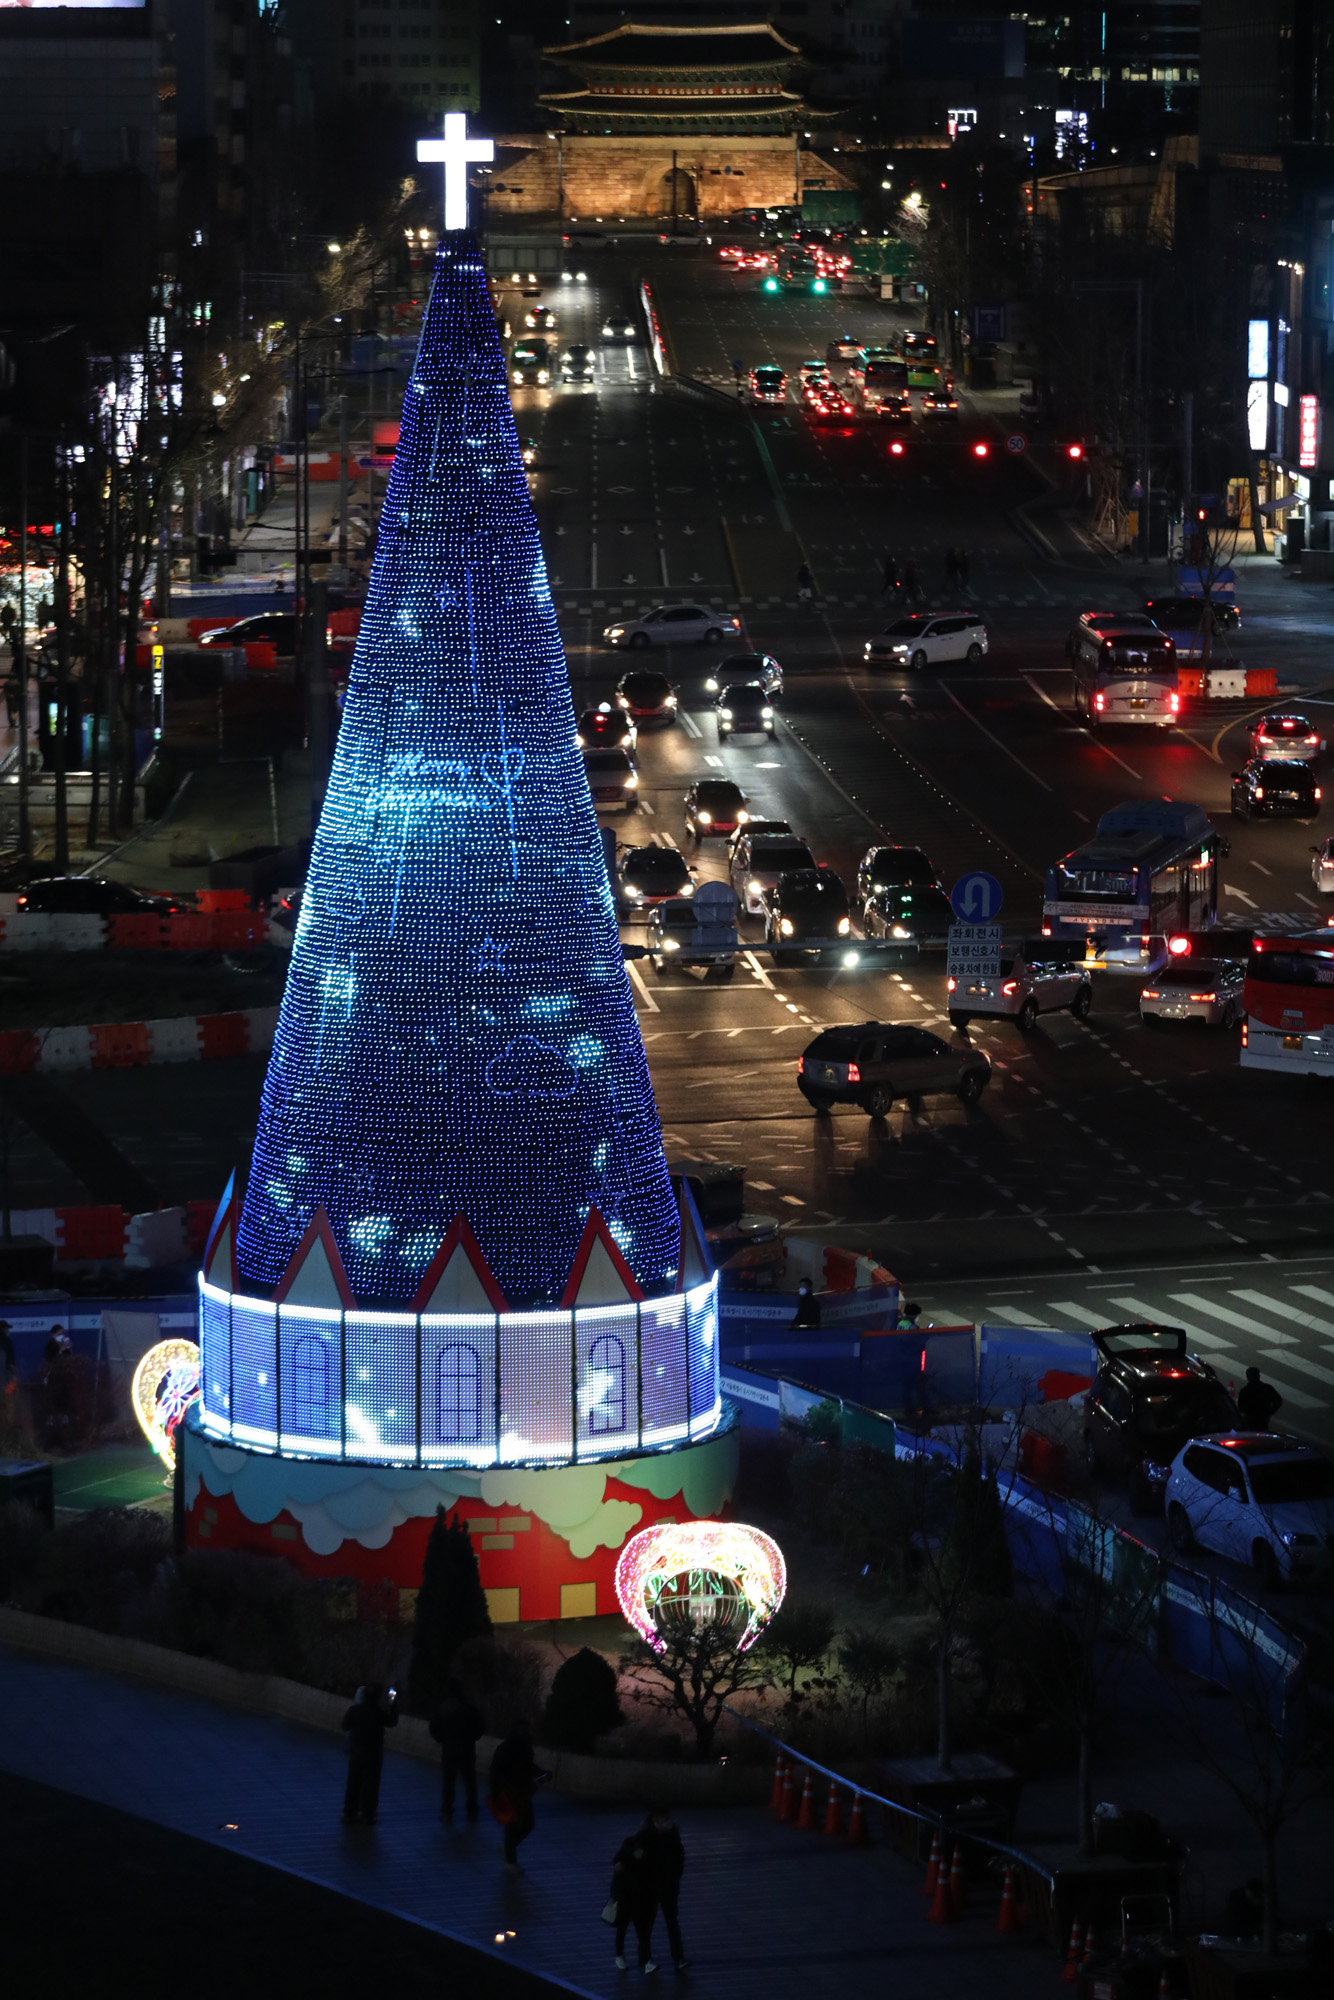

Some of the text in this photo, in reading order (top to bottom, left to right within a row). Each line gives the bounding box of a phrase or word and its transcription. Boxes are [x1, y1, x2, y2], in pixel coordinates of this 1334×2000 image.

[1009, 438, 1024, 450] 50
[387, 751, 474, 780] Merry
[952, 927, 999, 939] 좌회전시
[951, 945, 999, 957] 보행신호시
[950, 963, 998, 975] 승용차에 한함
